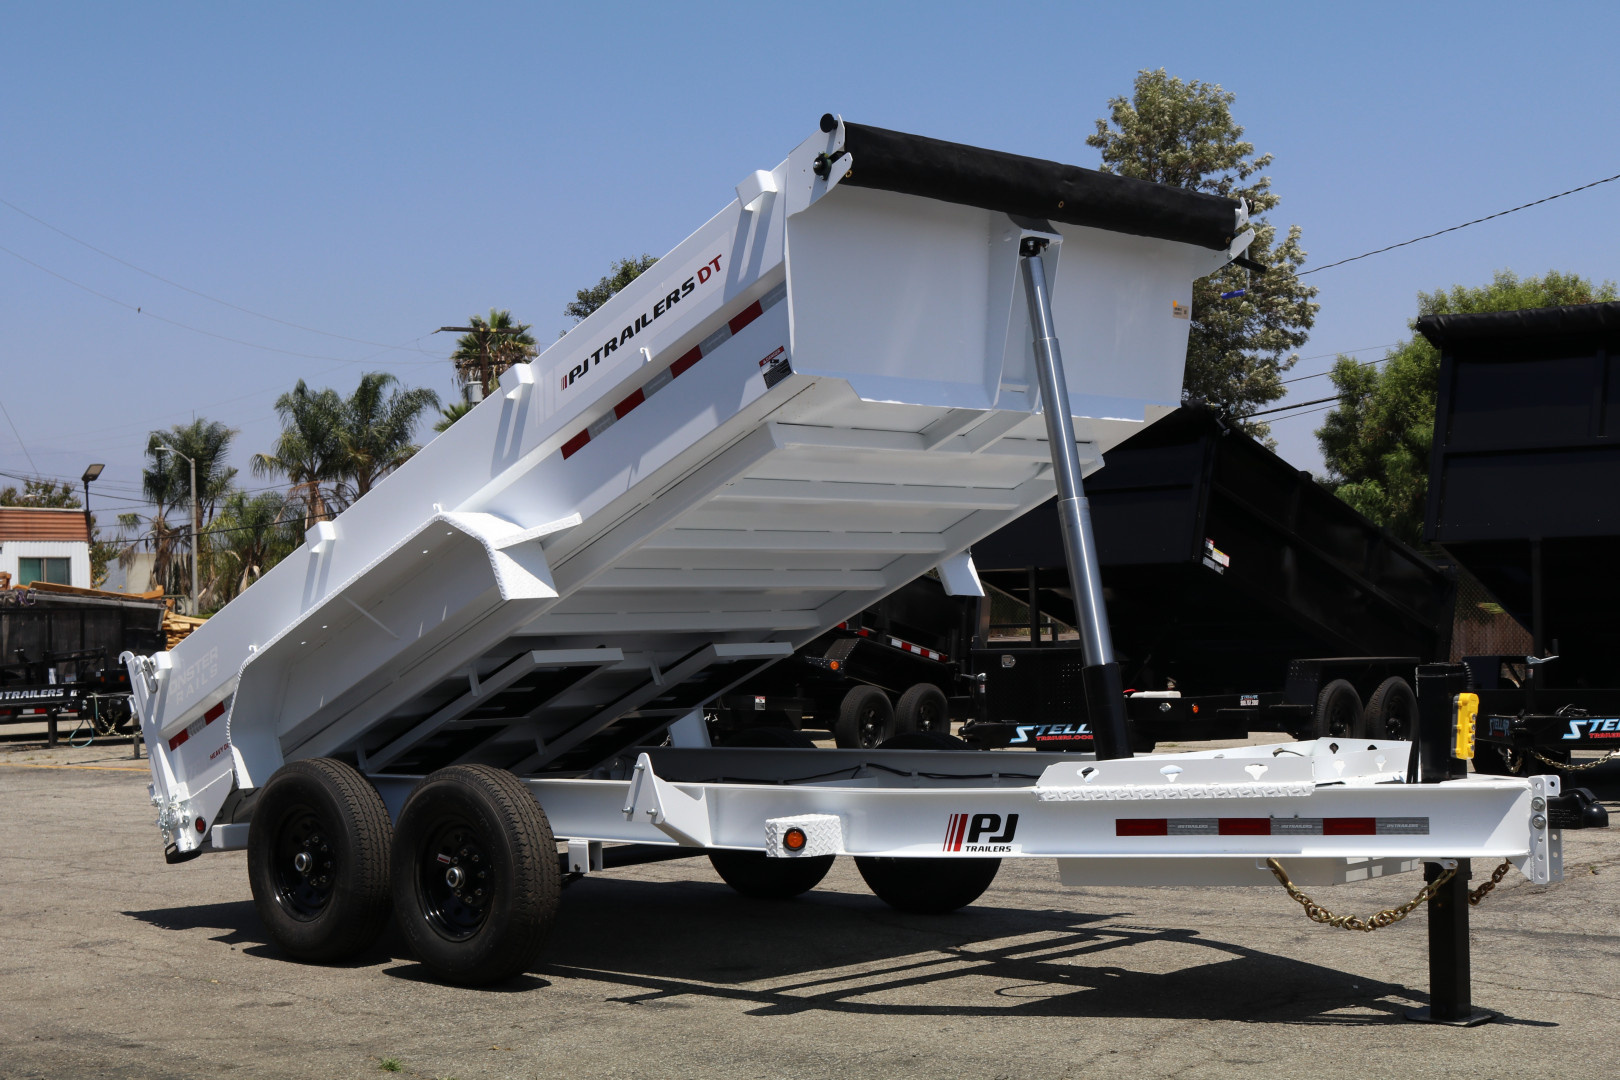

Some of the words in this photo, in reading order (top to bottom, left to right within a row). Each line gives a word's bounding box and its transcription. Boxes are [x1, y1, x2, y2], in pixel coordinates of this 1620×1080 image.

[590, 276, 696, 366] TRAILERS
[697, 253, 722, 285] DT
[169, 645, 218, 695] ONSTER
[5, 688, 64, 700] TRAILERS
[1009, 723, 1093, 743] STELL
[966, 813, 1020, 843] PJ
[965, 845, 1012, 853] TRAILERS
